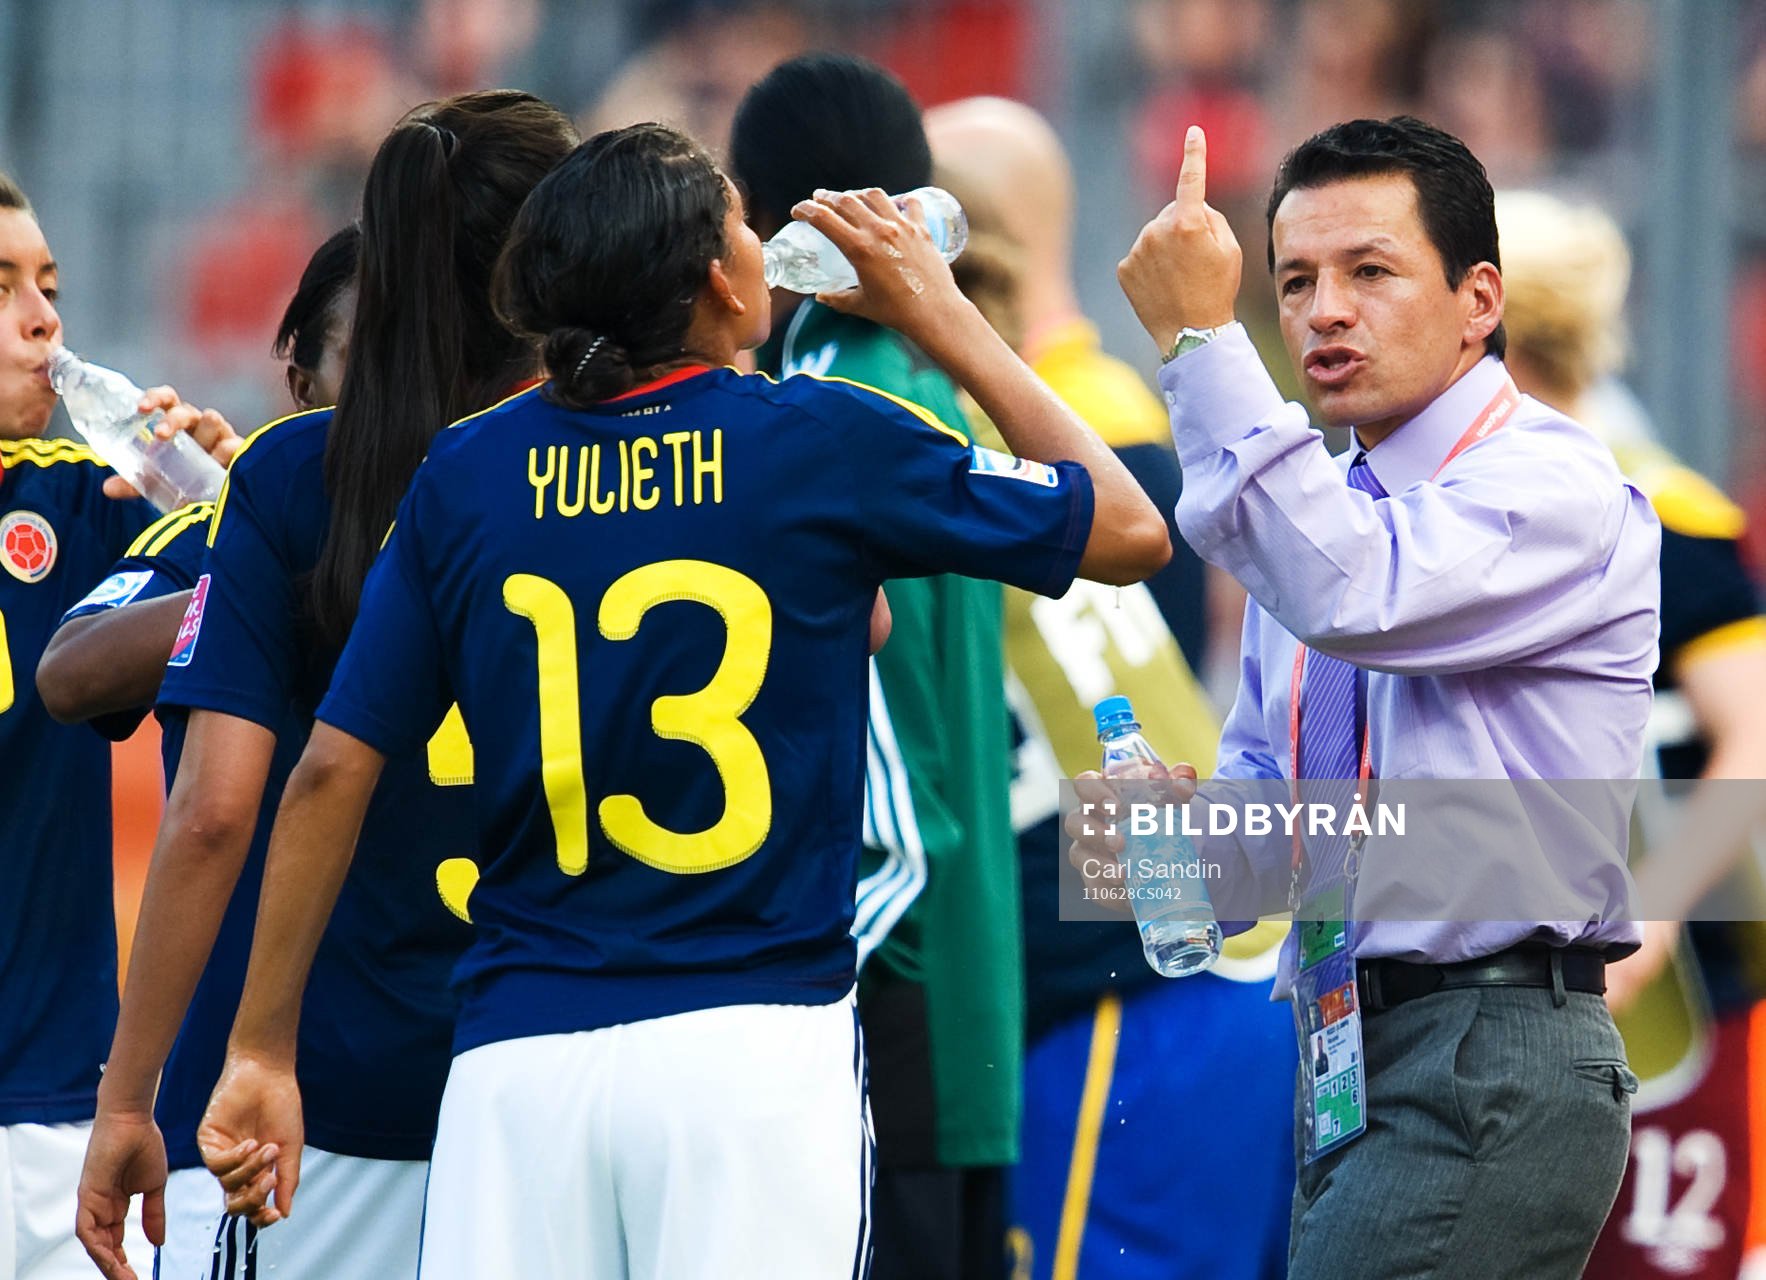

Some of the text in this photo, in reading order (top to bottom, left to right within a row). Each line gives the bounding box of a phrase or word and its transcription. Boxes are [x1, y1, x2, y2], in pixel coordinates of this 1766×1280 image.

[527, 427, 723, 520] YULIETH
[502, 558, 773, 877] 13
[1352, 1089, 1358, 1104] 6
[1620, 1126, 1729, 1248] 12
